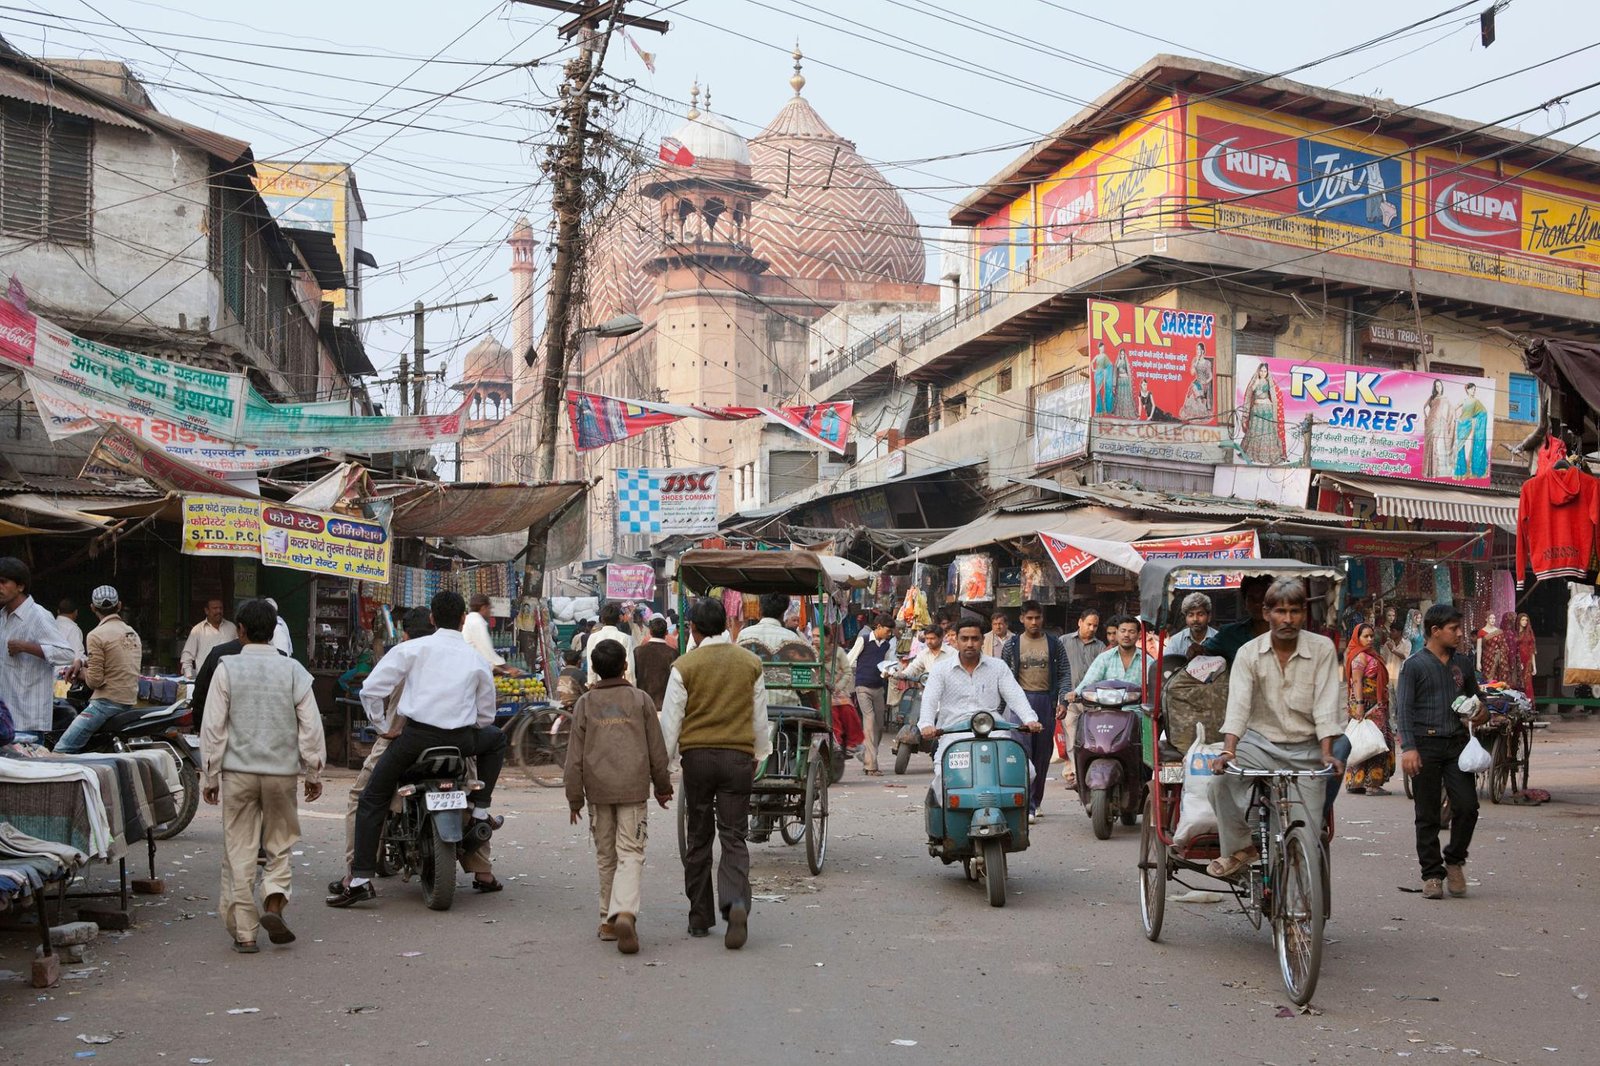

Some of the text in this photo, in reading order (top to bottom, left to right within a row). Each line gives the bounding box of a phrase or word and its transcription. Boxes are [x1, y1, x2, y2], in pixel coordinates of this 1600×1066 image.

[1226, 147, 1292, 183] RUPA
[1299, 153, 1367, 207] Jon
[1057, 189, 1095, 225] RUPA
[1452, 190, 1517, 222] RUPA
[1091, 302, 1214, 347] R.K. SAREE'S
[70, 352, 108, 380] आल
[1290, 366, 1391, 406] R.K.
[1328, 407, 1417, 432] SAREE'S
[103, 437, 136, 461] SUNRISE
[269, 512, 320, 530] फोटो स्टेट
[331, 523, 384, 542] लेमिनेशन
[192, 530, 228, 540] S.T.D.
[290, 536, 309, 550] कलर
[310, 537, 325, 552] फोटो
[346, 541, 363, 558] तैयार
[1182, 537, 1213, 547] SALE
[1224, 533, 1252, 545] SALE
[292, 553, 313, 566] फोटो
[315, 555, 338, 570] सेन्टर
[1061, 551, 1092, 573] SALE
